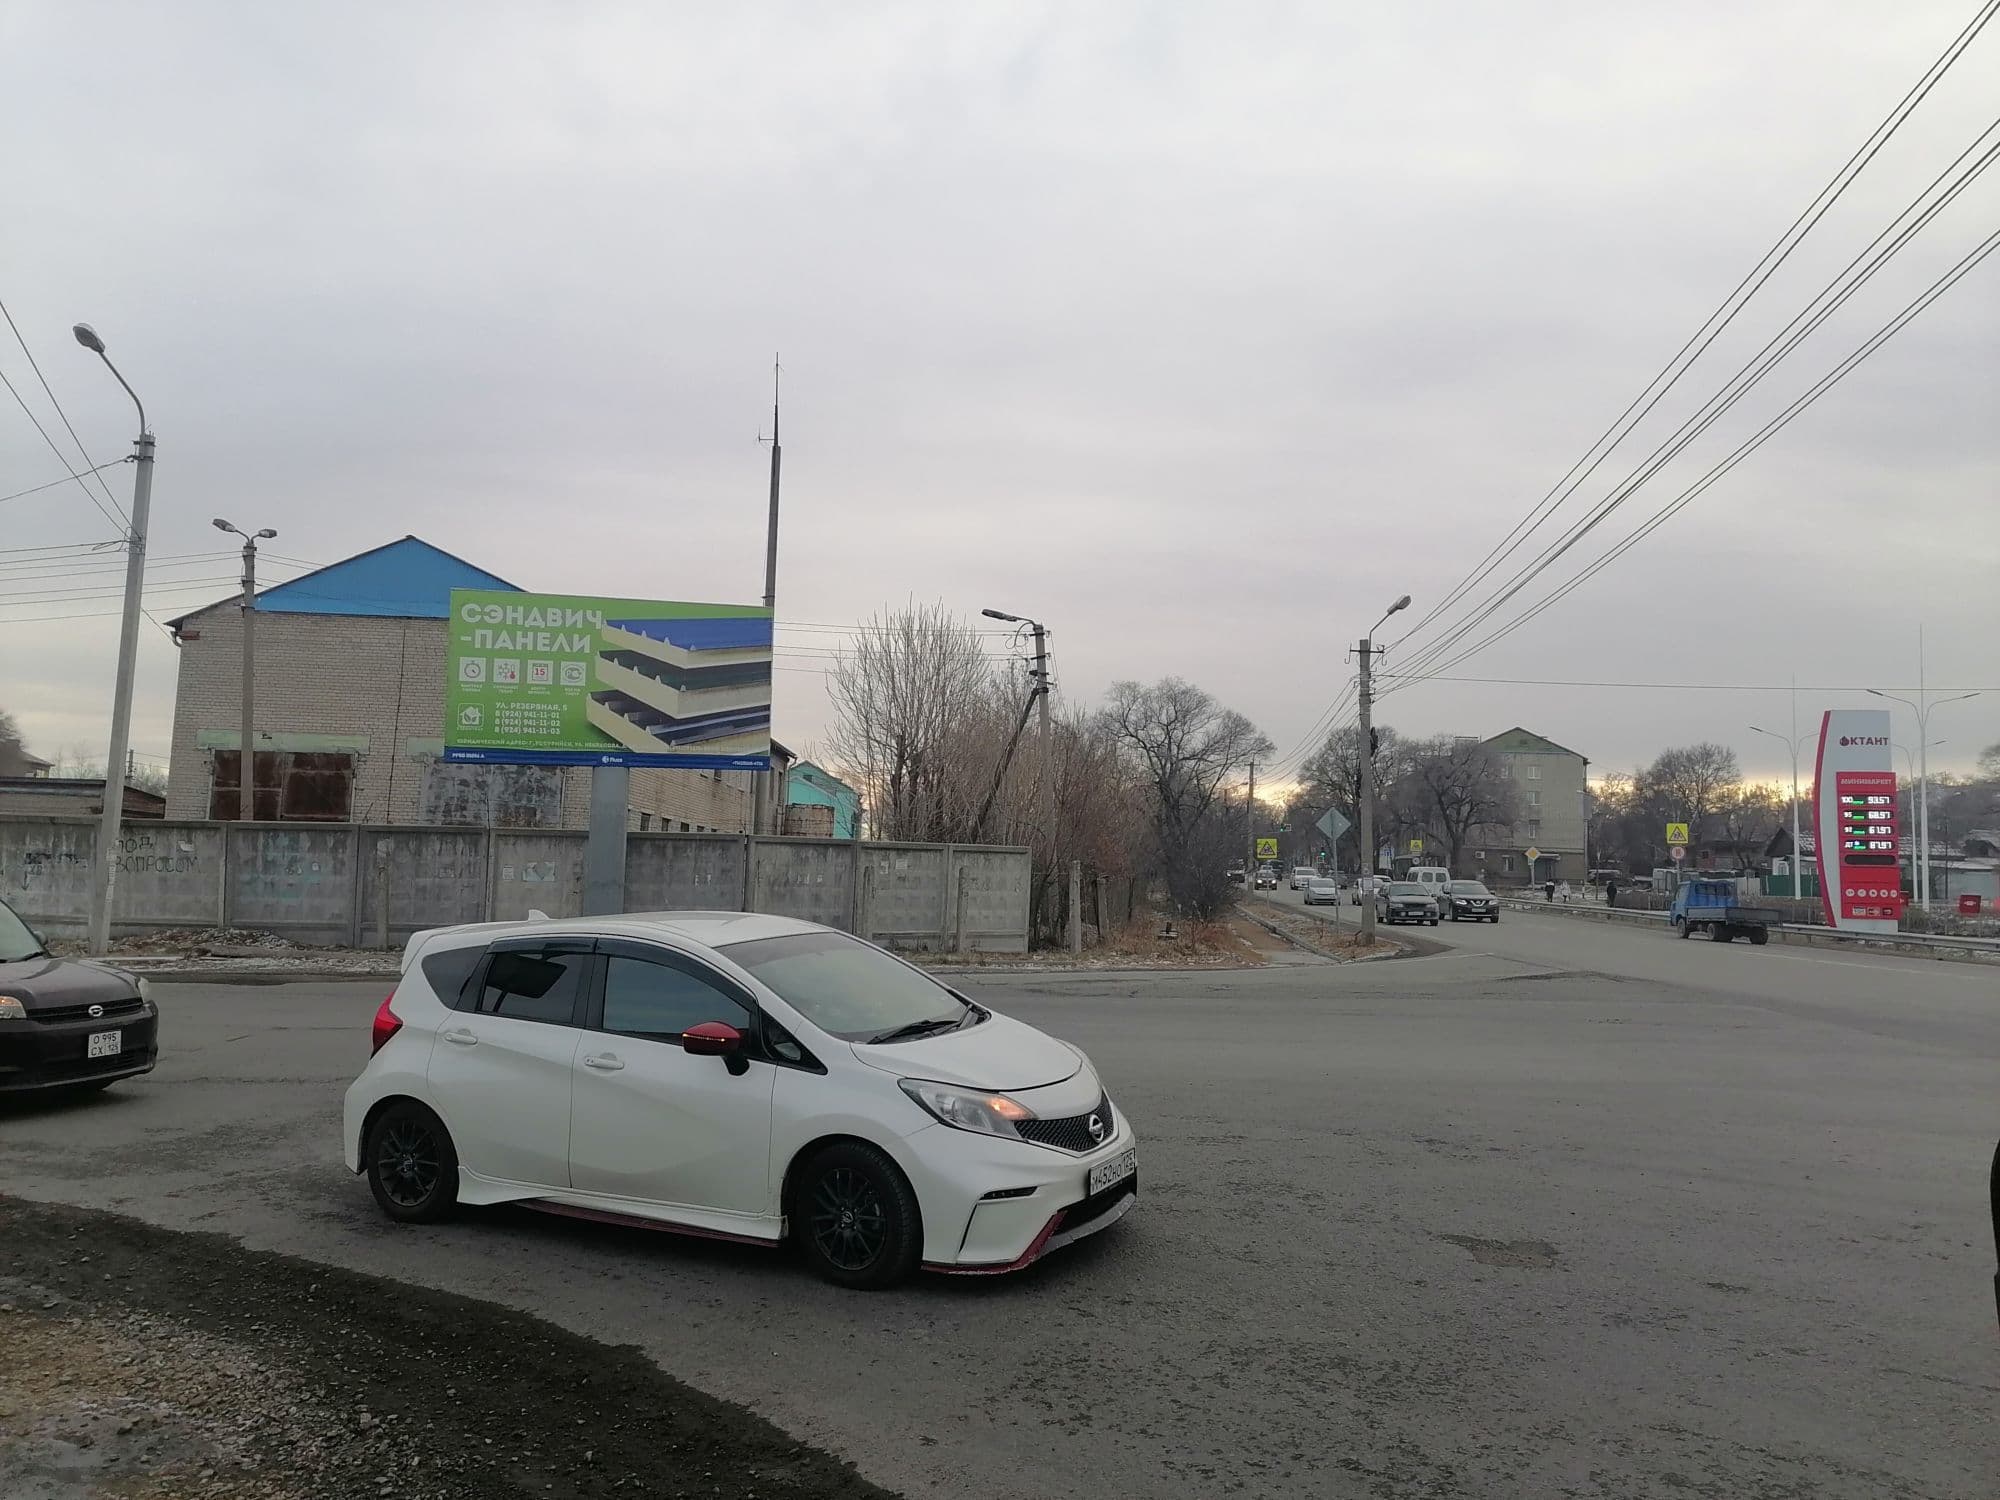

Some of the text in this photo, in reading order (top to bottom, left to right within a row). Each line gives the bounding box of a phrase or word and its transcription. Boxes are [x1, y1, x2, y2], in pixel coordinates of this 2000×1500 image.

[461, 603, 603, 629] СЭНДВИЧ
[460, 627, 591, 654] -ПАНЕЛИ
[102, 1032, 117, 1042] 995
